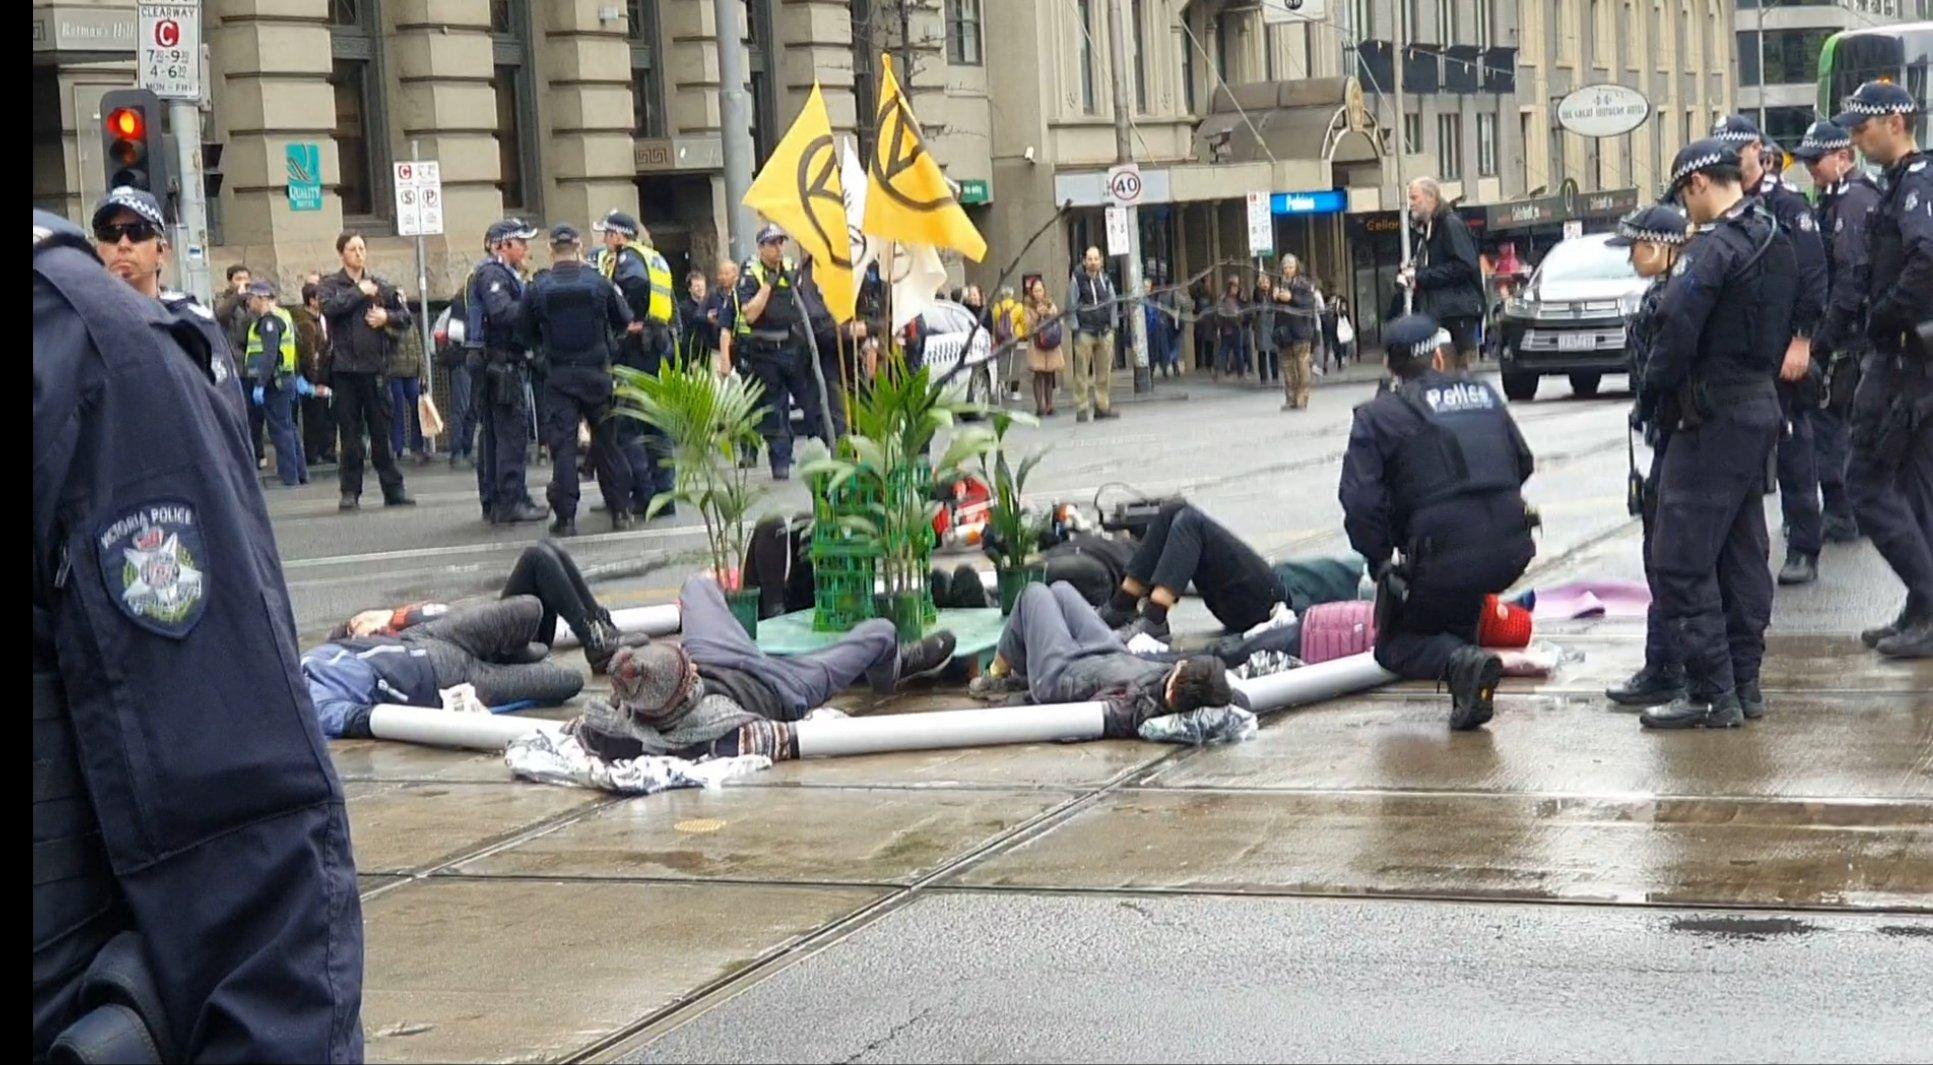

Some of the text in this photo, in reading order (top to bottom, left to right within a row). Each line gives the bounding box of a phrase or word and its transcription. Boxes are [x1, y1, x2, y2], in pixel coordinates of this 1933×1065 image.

[141, 6, 195, 18] CLEARWAY
[1116, 178, 1137, 193] 40
[289, 186, 320, 201] QUALITY
[100, 506, 191, 549] VICTORIA POLICE
